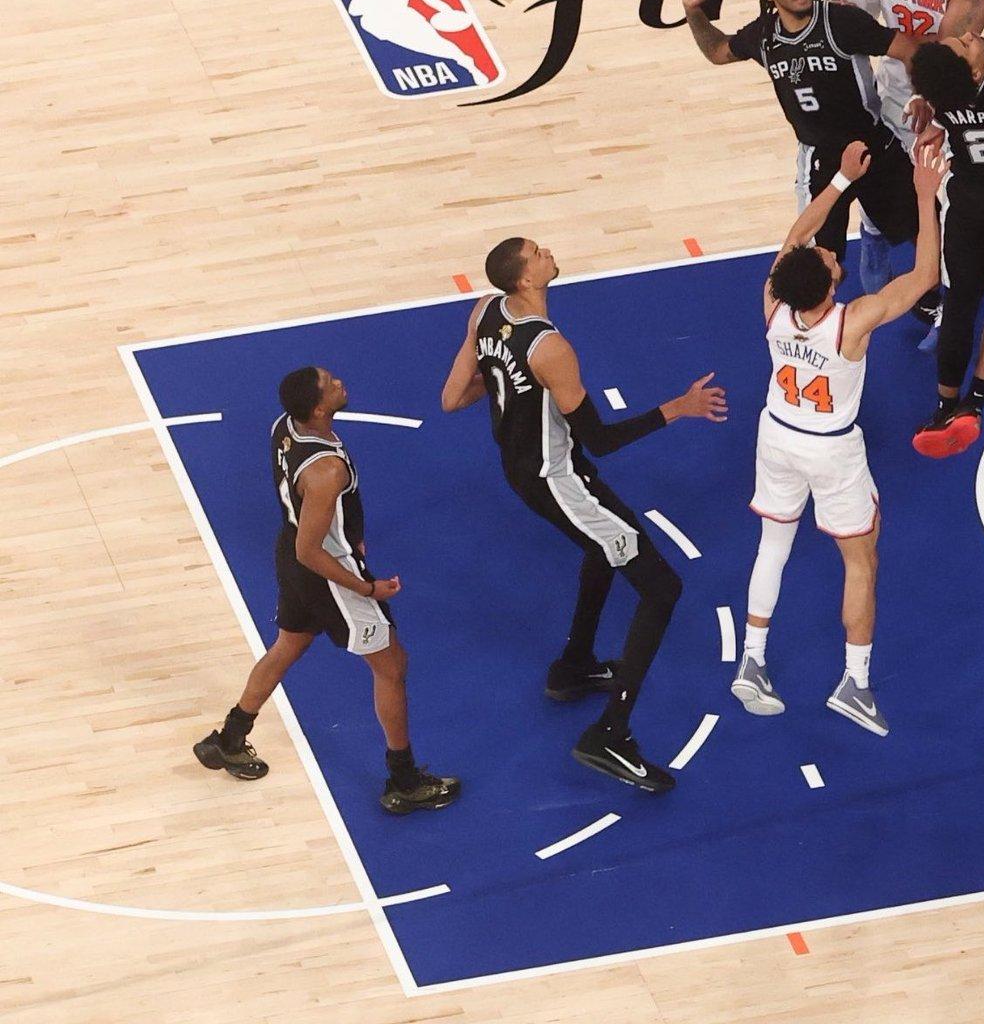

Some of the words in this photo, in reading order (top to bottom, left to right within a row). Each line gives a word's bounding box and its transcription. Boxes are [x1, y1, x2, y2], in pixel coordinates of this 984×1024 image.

[892, 3, 934, 37] 32
[392, 61, 459, 92] NBA
[769, 56, 838, 84] SPURS
[794, 86, 820, 112] 5
[776, 339, 830, 371] SHAMET
[776, 364, 834, 414] 44
